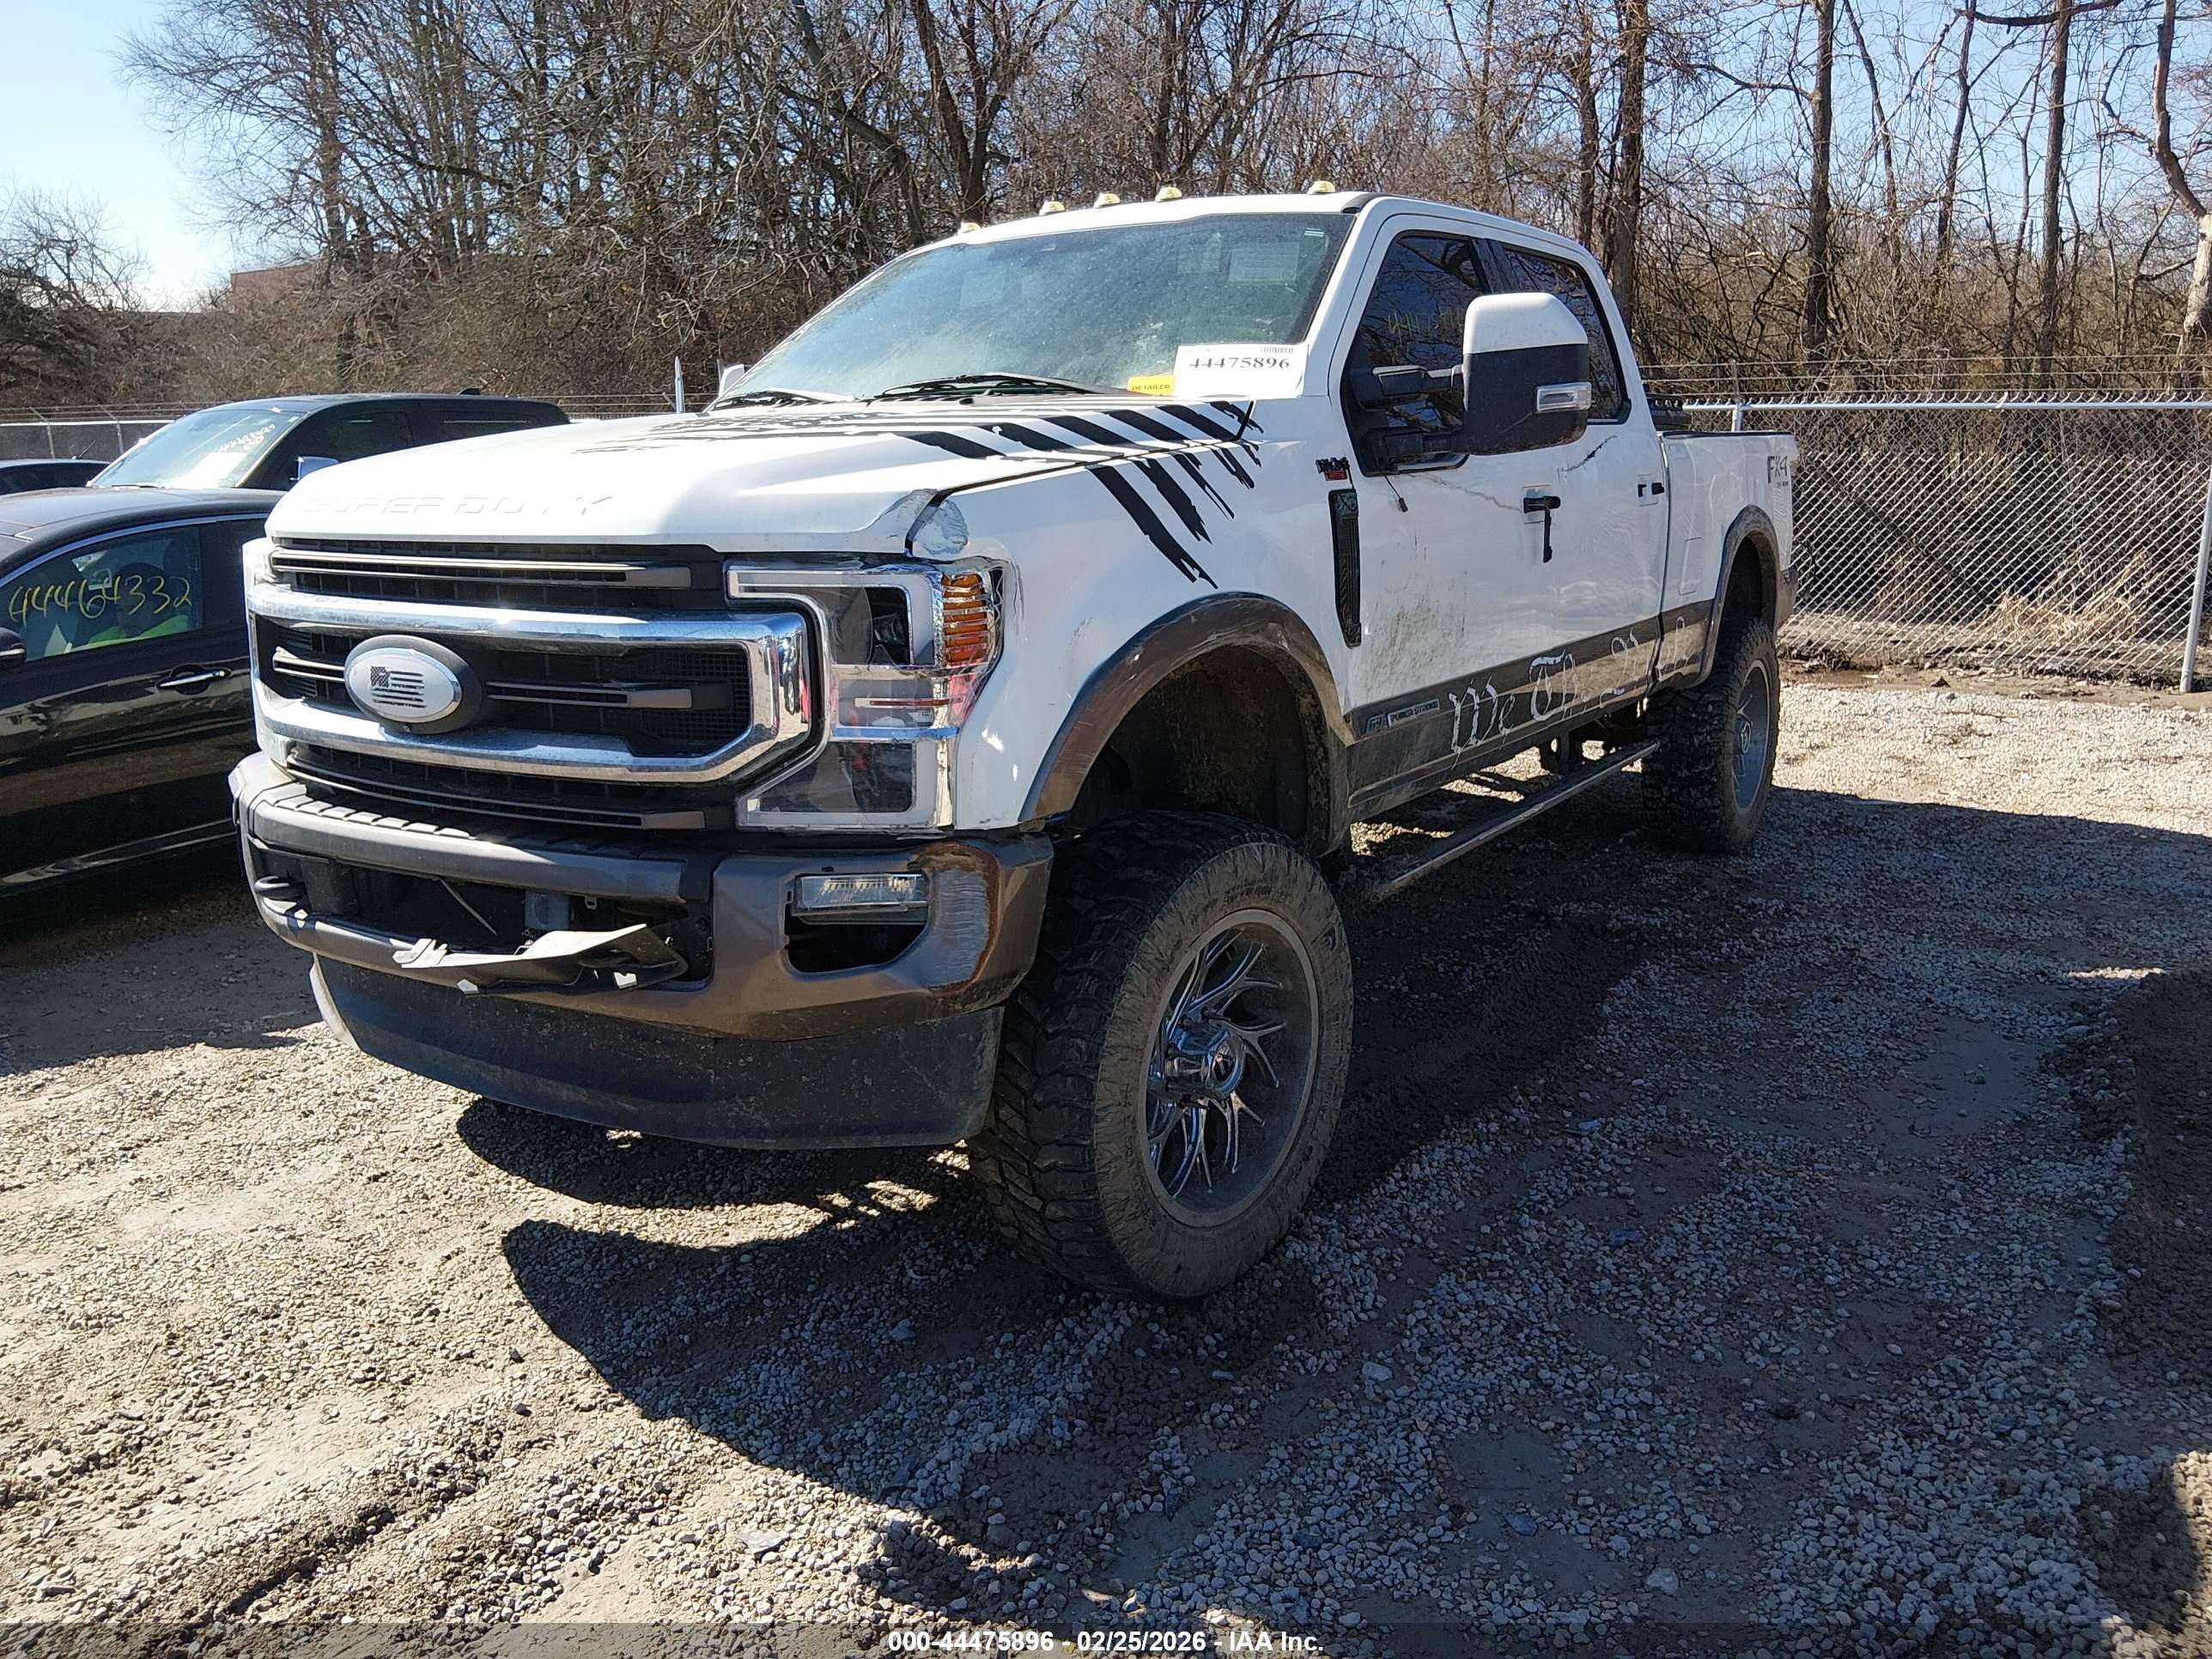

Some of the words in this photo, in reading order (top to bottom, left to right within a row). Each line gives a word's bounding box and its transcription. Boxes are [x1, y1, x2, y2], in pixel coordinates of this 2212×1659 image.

[1188, 356, 1290, 369] 44475896
[1767, 455, 1788, 483] FX4
[453, 495, 613, 515] DUY
[9, 574, 192, 627] 44464332
